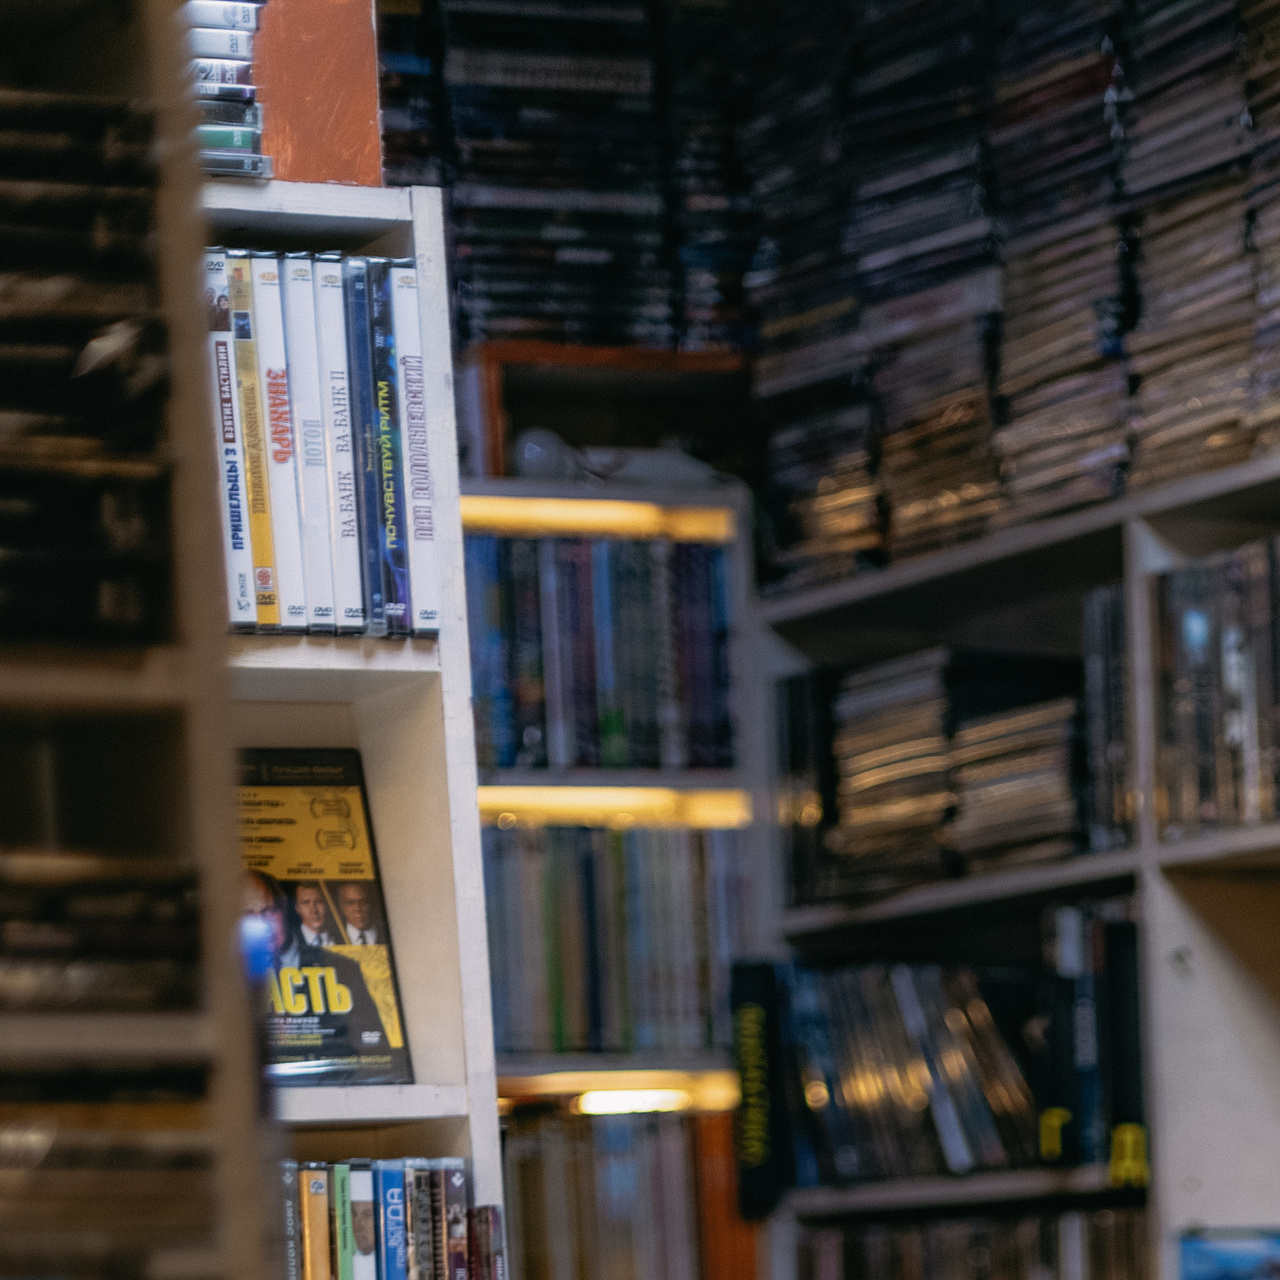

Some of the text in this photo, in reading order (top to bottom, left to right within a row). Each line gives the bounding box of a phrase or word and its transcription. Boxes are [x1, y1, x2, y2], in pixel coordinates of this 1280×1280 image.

[217, 345, 235, 442] ВЗЯТИЕ БАСТИЛИИ
[266, 368, 293, 463] ЗНАХАРЬ
[332, 386, 350, 453] ВА-БАНК
[302, 419, 325, 467] ПОТОП
[377, 381, 397, 550] ПОЧУВСТВУЙ РИТМ
[225, 447, 244, 550] ПРИШЕЛЬЦЫ 3
[338, 471, 356, 538] ВА-БАНК
[412, 504, 434, 541] ПАН
[267, 966, 353, 1015] АСТЬ
